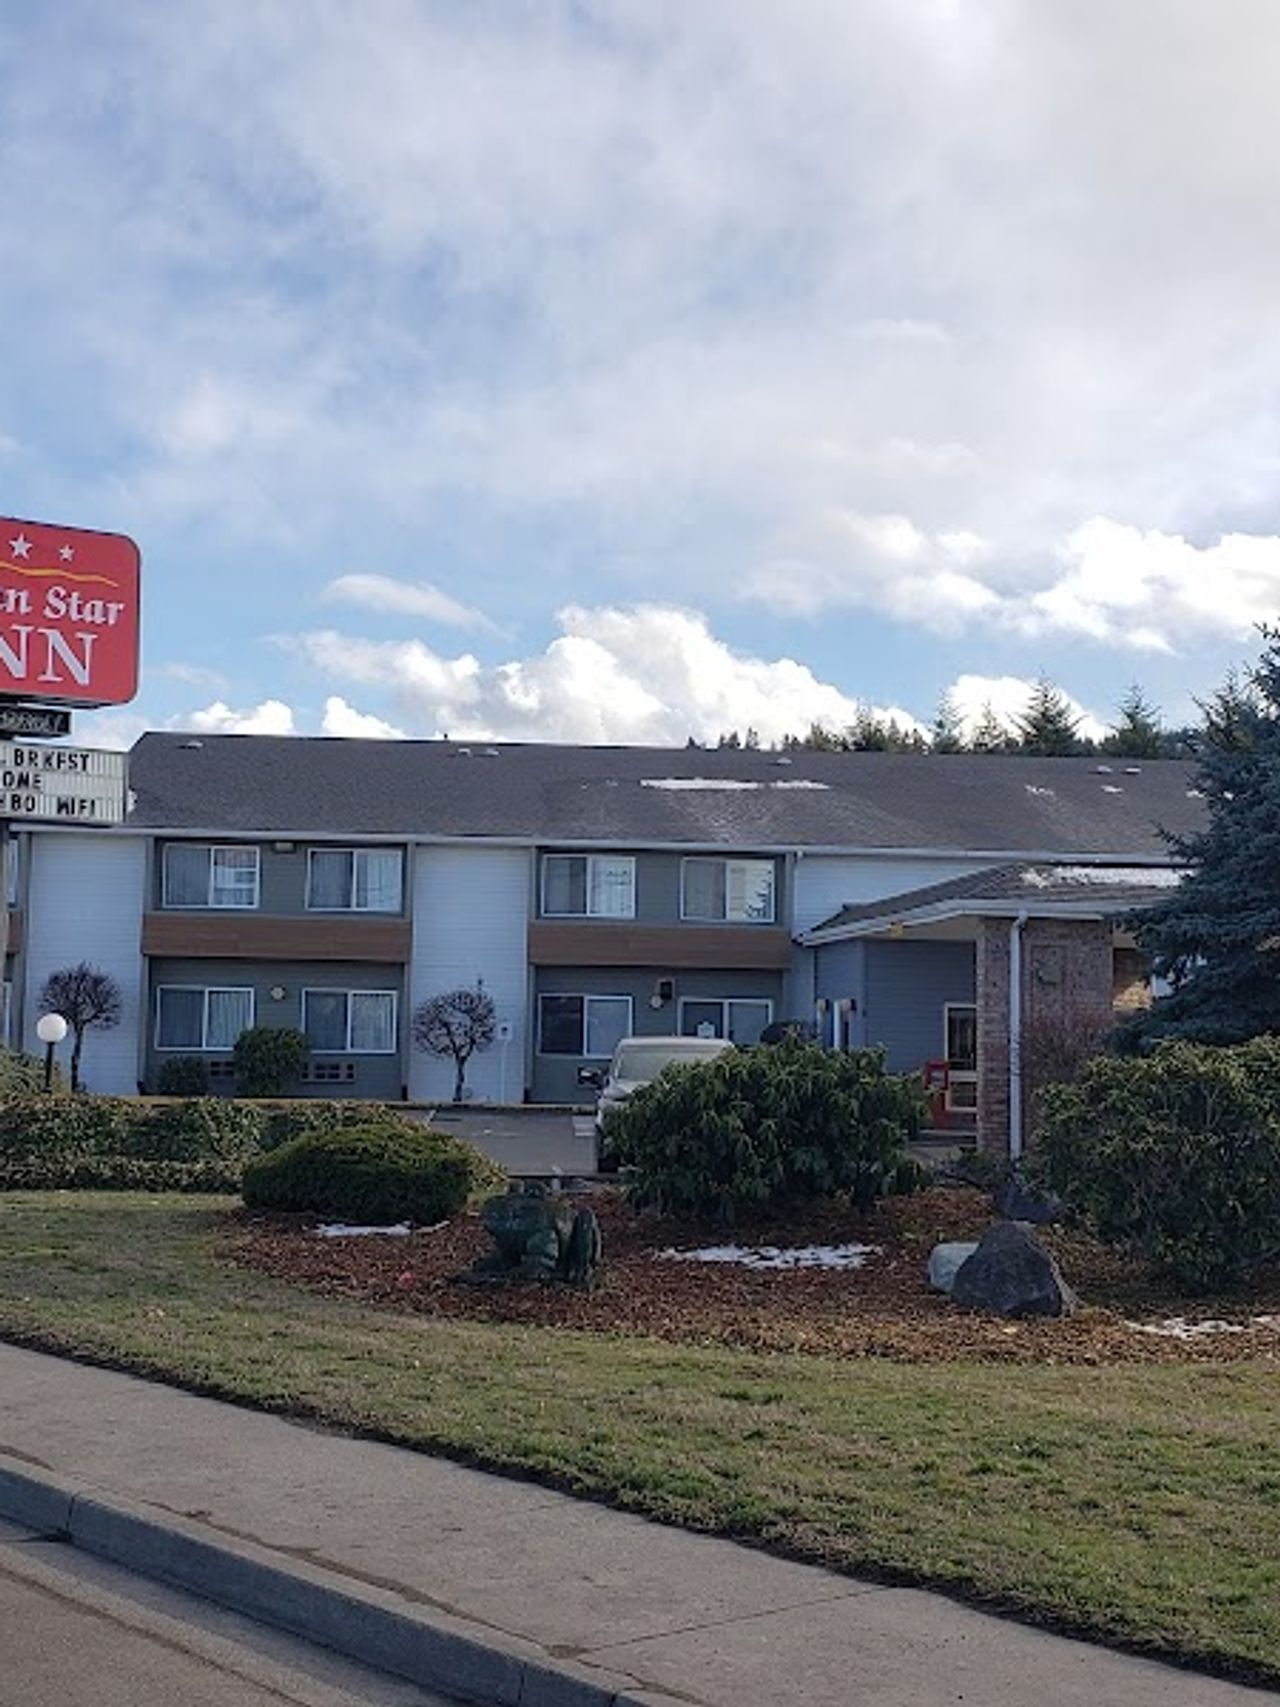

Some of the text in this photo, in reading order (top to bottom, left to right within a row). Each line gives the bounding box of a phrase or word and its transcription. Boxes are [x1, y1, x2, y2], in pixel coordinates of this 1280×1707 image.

[0, 585, 125, 626] n Star
[14, 748, 89, 772] BRKFST
[57, 797, 96, 815] WIFI
